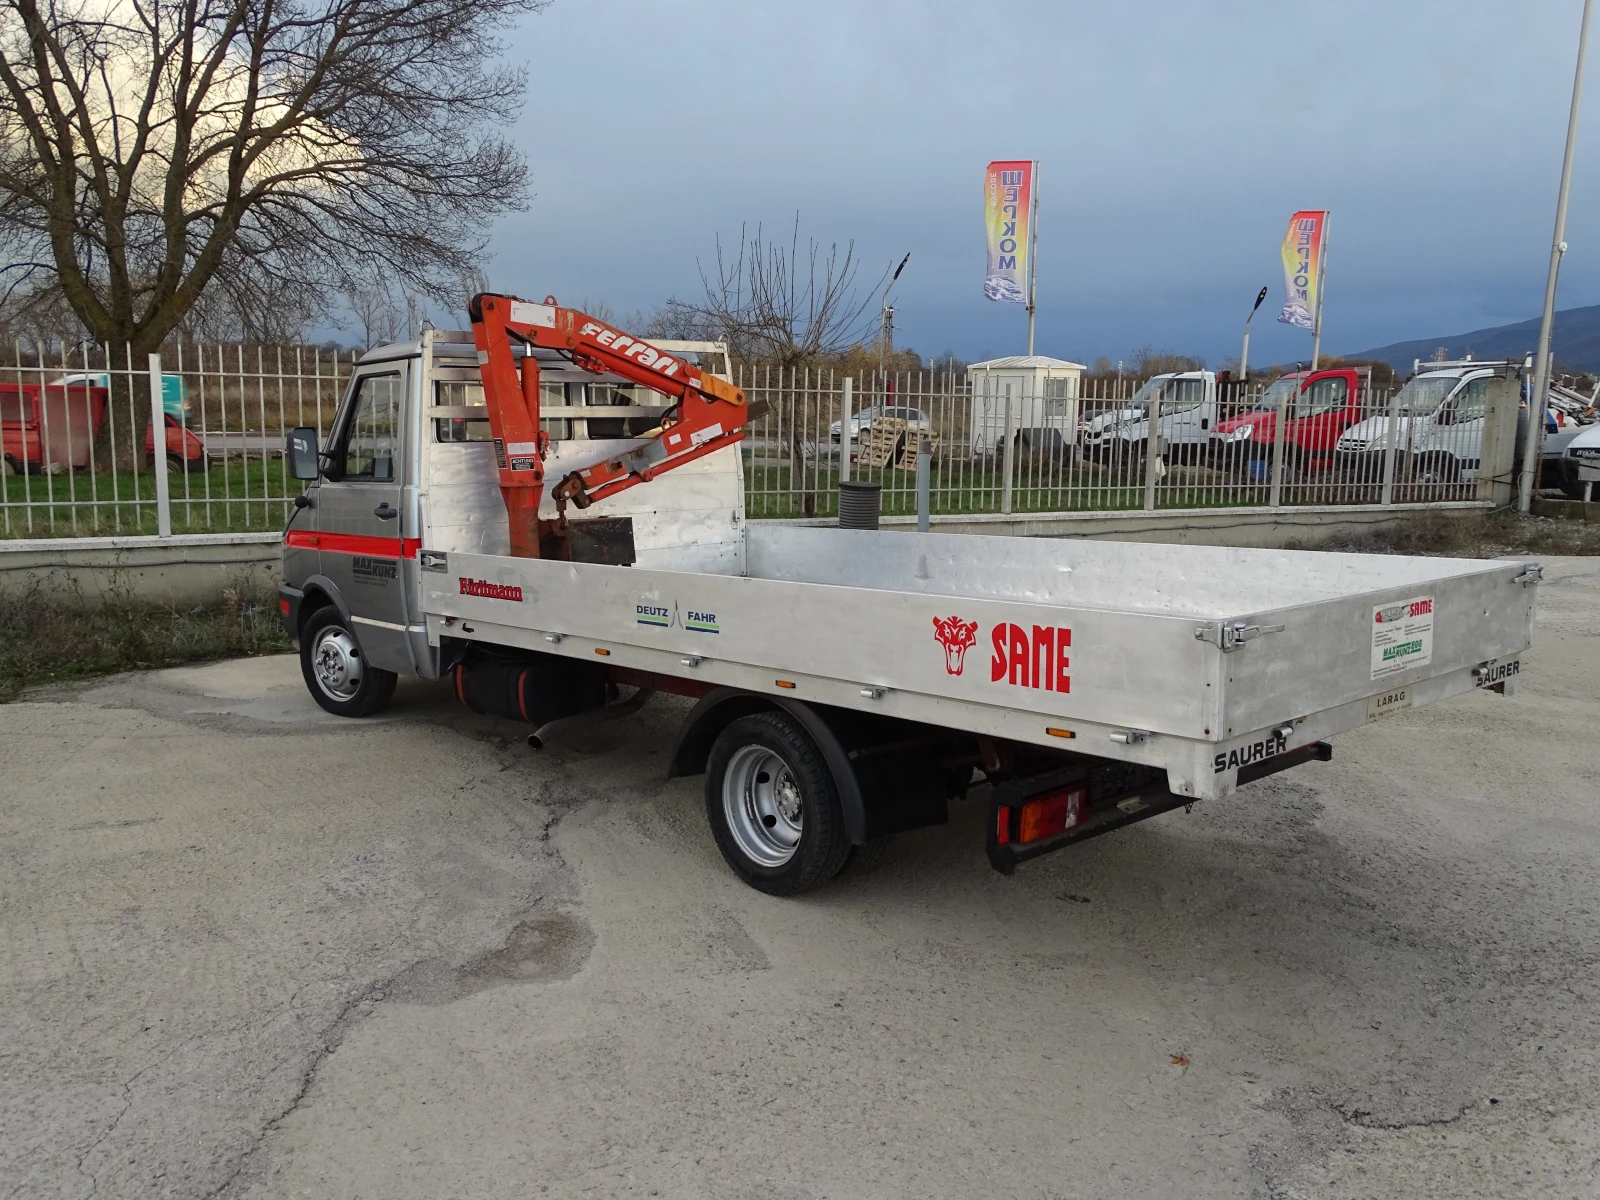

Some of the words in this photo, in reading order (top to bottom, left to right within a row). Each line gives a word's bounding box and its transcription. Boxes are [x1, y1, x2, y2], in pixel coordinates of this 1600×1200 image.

[353, 557, 372, 570] MAX
[373, 565, 396, 578] KUNZ
[636, 605, 668, 617] DEUTZ
[688, 611, 716, 623] FAHR
[1410, 599, 1432, 617] SAME
[991, 622, 1071, 694] SAME
[1475, 660, 1520, 687] SAURER
[1377, 691, 1405, 707] LARAG
[1215, 736, 1287, 774] SAURER
